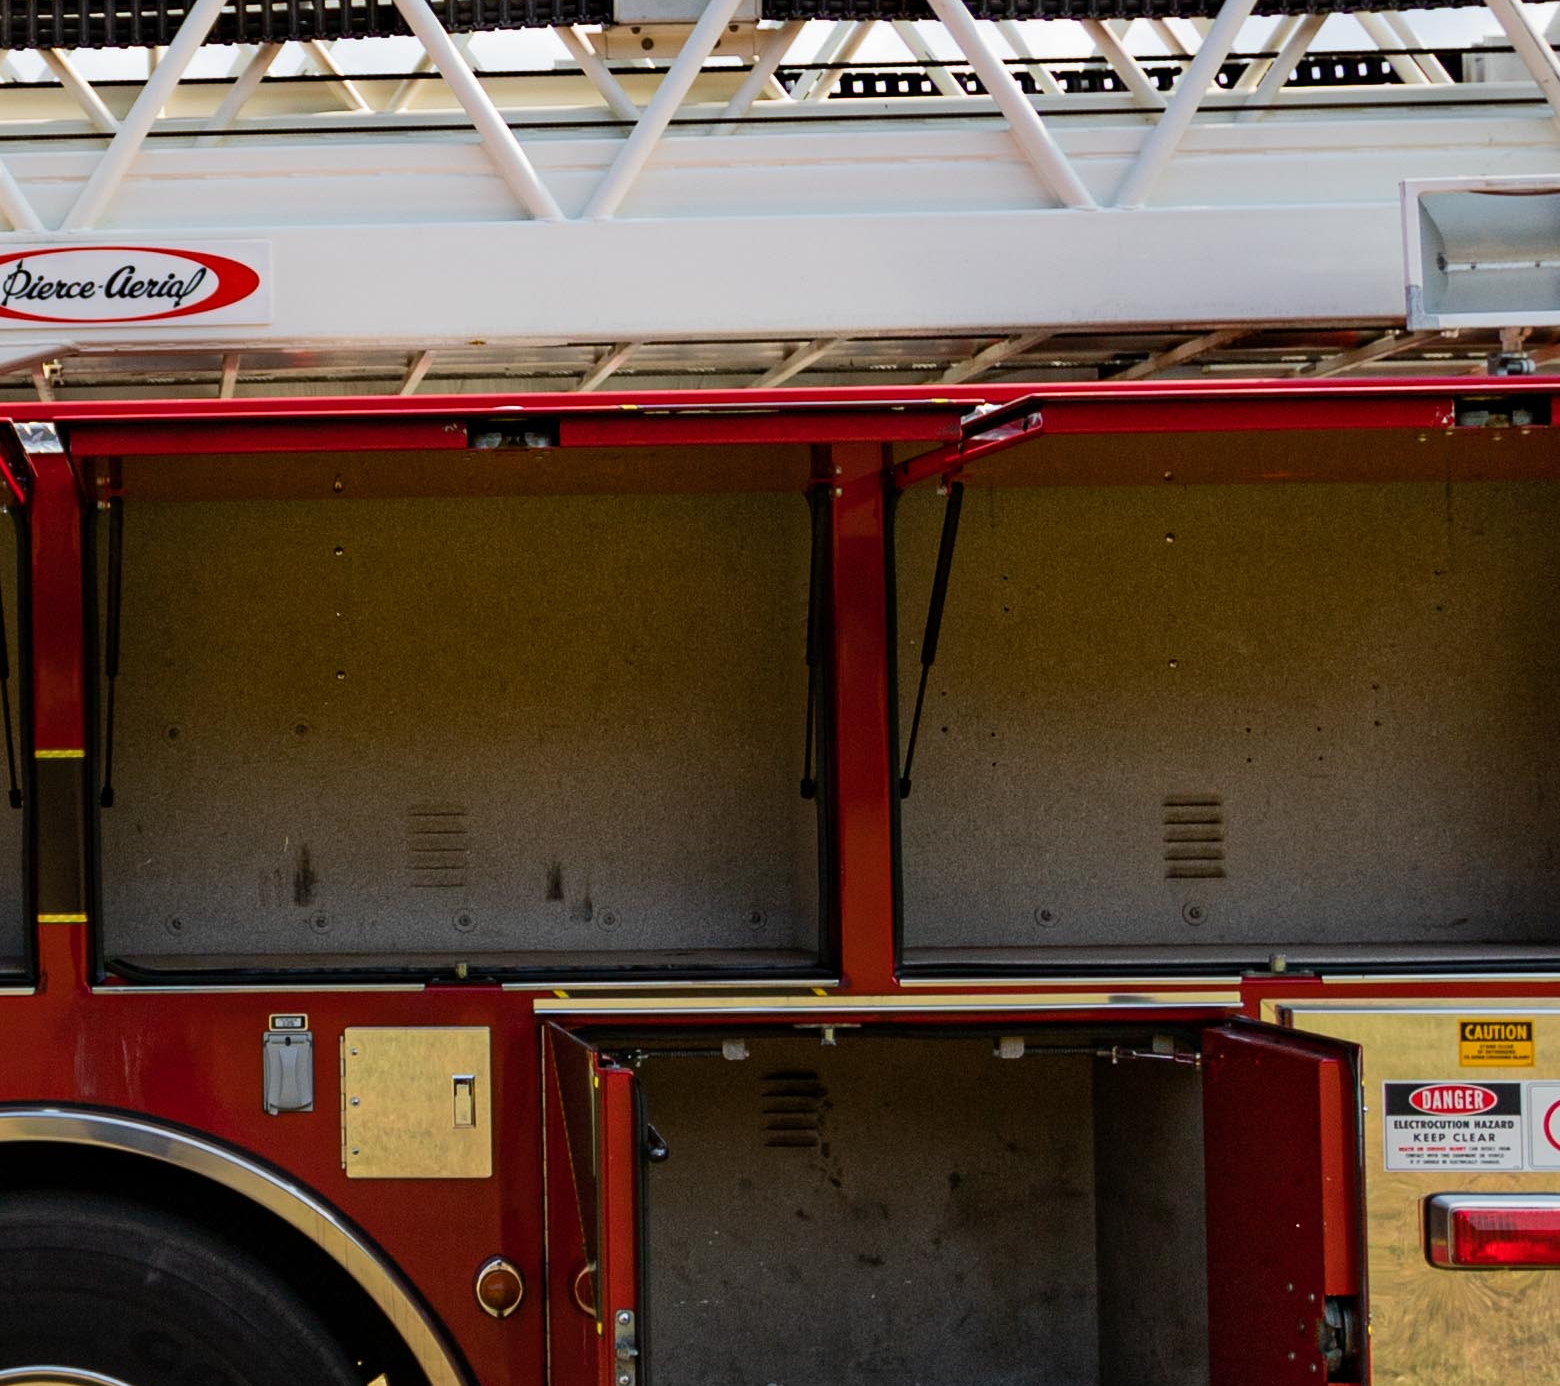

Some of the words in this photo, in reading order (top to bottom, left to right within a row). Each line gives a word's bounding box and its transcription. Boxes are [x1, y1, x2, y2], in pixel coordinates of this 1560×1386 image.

[1464, 1023, 1528, 1040] CAUTION
[1421, 1089, 1484, 1110] DANGER
[1393, 1120, 1470, 1130] ELECTROCUTION
[1474, 1120, 1515, 1130] HAZARD
[1413, 1133, 1446, 1143] KEEP
[1453, 1133, 1496, 1143] CLEAR
